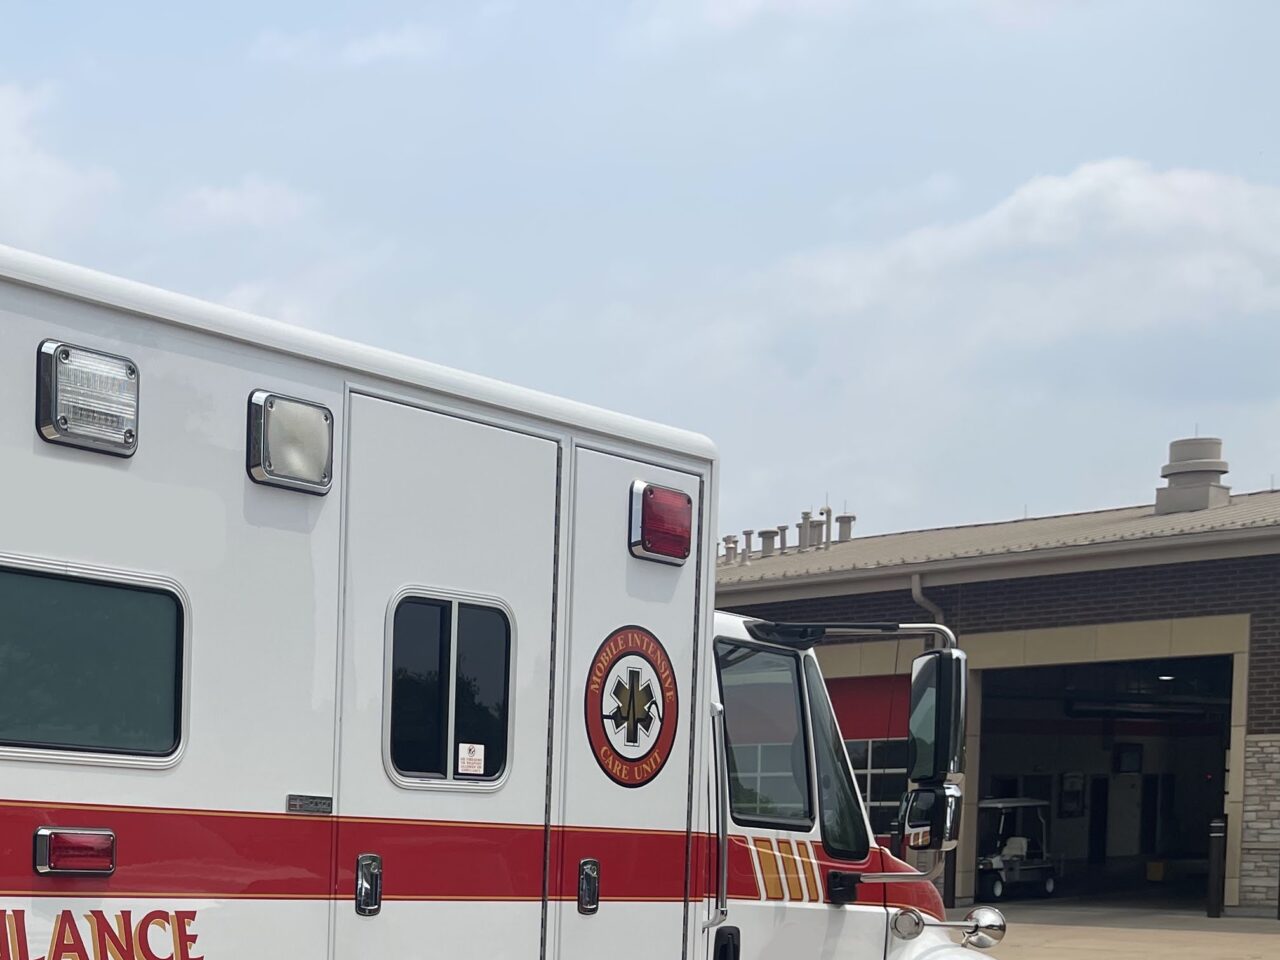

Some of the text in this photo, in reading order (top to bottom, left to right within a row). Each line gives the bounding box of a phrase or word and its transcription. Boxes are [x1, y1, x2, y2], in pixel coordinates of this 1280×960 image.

[590, 632, 674, 703] MOBILE INTENSIVE
[600, 746, 661, 780] CARE UNIT
